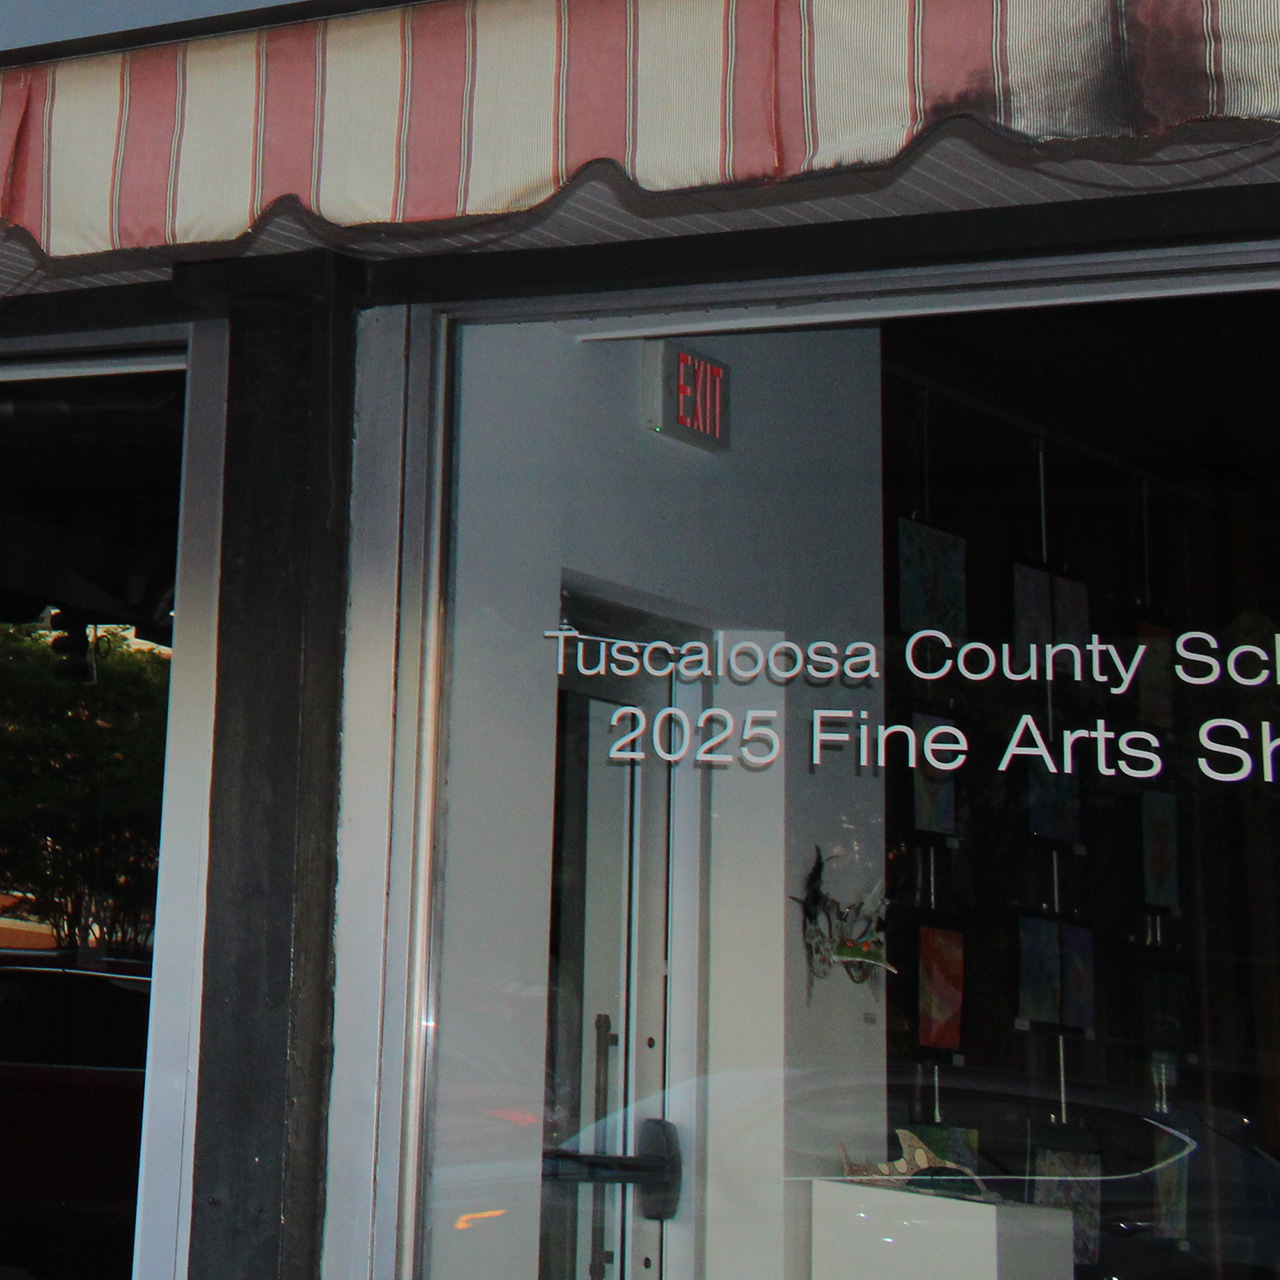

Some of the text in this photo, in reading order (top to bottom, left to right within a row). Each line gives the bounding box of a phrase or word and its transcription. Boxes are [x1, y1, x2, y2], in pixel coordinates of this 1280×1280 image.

[677, 351, 723, 439] EXIT
[544, 629, 880, 680] Tuscaloosa
[905, 629, 1147, 694] County
[608, 706, 781, 765] 2025
[811, 709, 969, 771] Fine
[998, 714, 1163, 778] Arts
